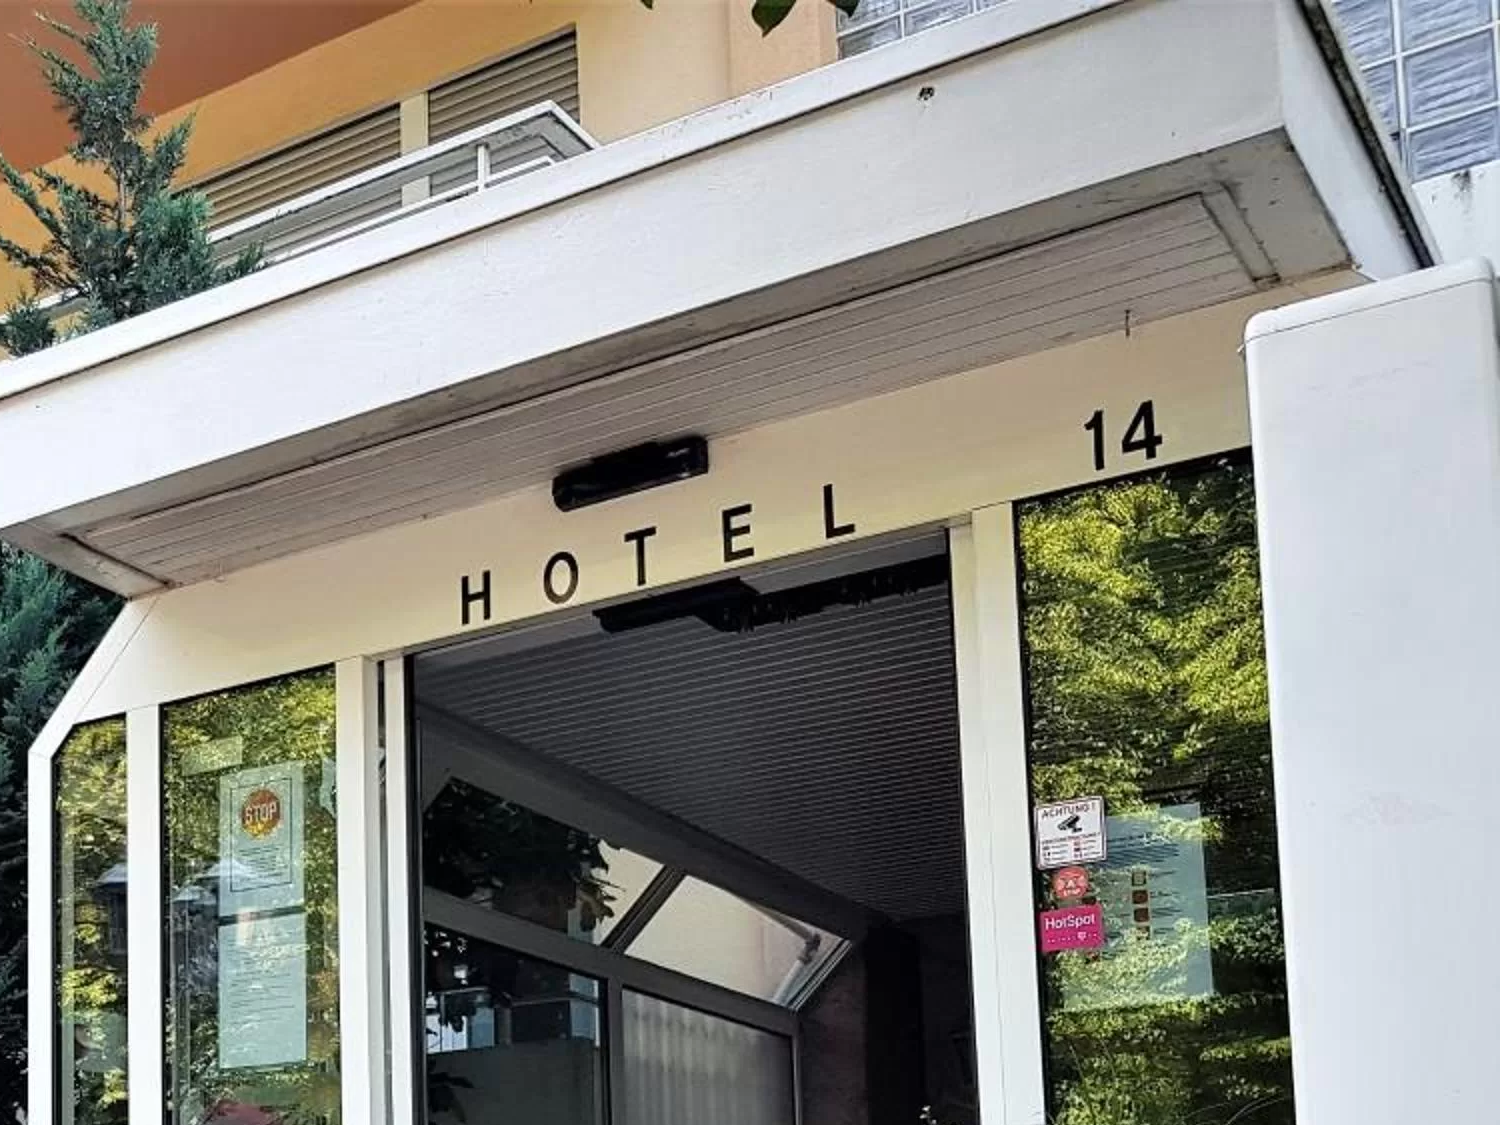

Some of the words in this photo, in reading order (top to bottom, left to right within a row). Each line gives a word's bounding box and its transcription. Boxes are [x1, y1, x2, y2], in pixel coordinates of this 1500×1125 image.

[1084, 400, 1162, 471] 14
[460, 484, 856, 625] HOTEL
[245, 802, 276, 824] STOP
[1044, 913, 1095, 930] HotSpot
